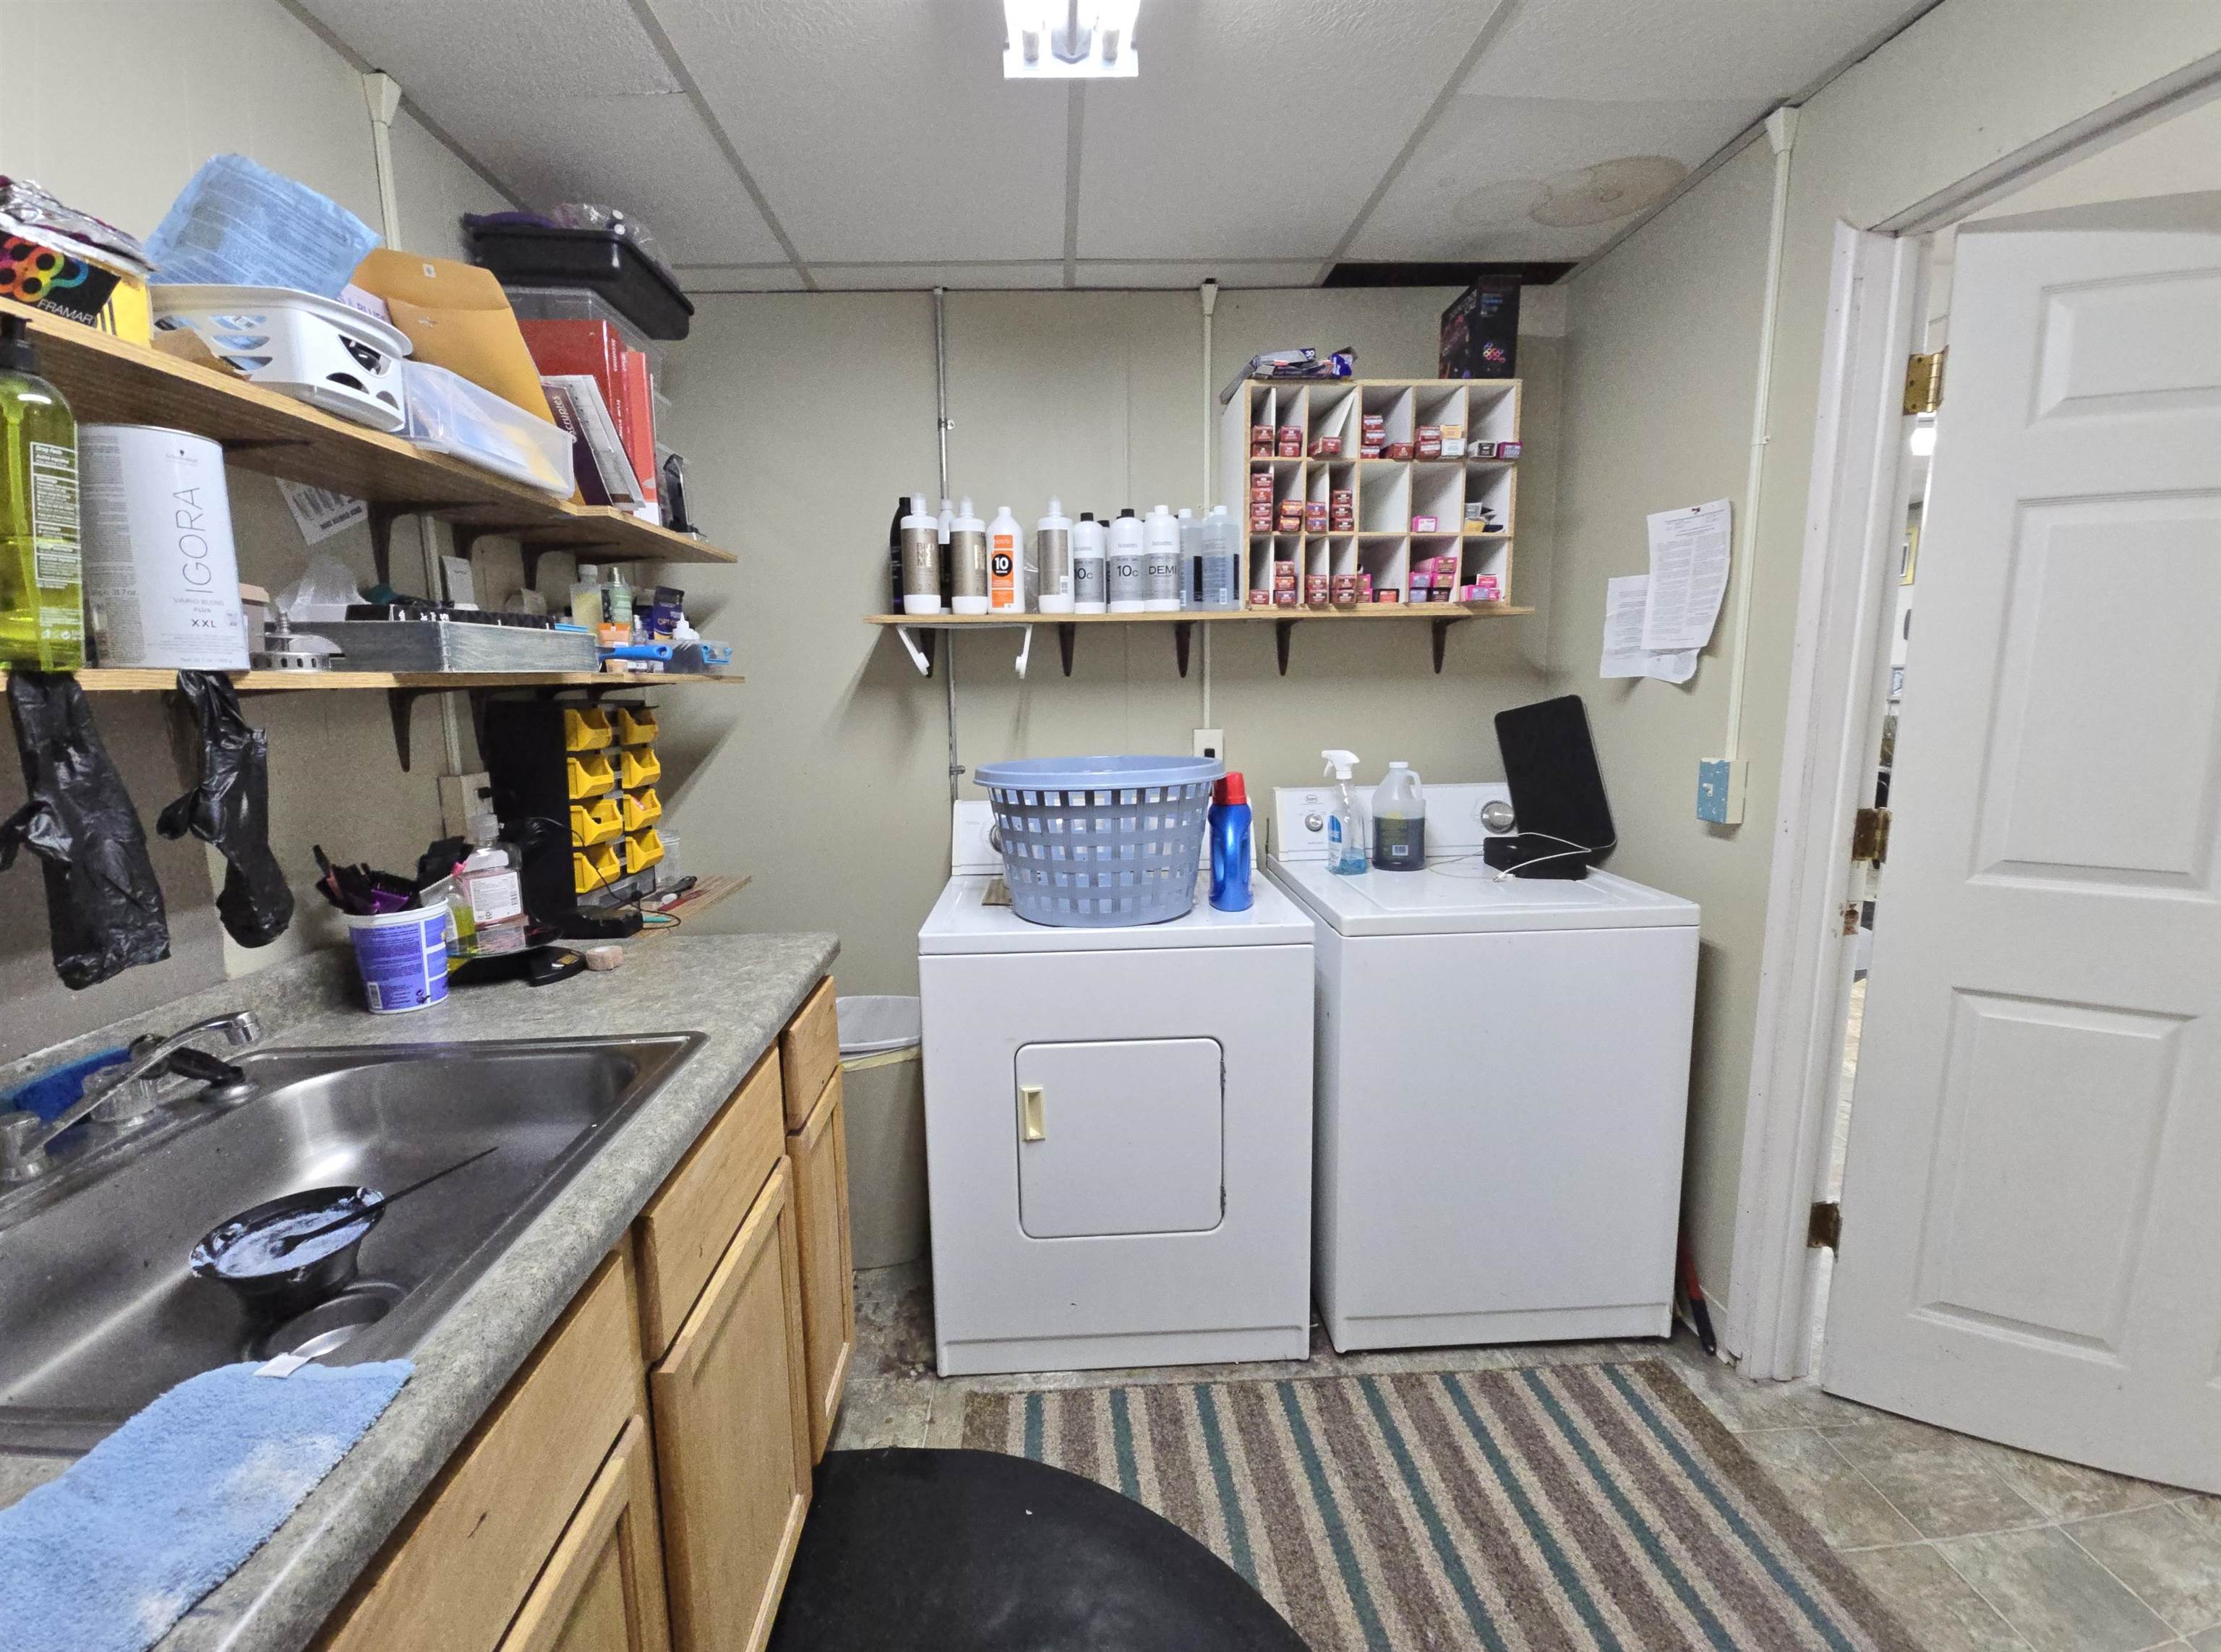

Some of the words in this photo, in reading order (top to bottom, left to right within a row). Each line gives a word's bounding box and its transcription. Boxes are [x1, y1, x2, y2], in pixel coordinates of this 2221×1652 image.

[37, 298, 94, 325] FRAMAR
[172, 487, 214, 593] IGORA
[995, 557, 1009, 570] 10
[1149, 565, 1177, 575] DEMI
